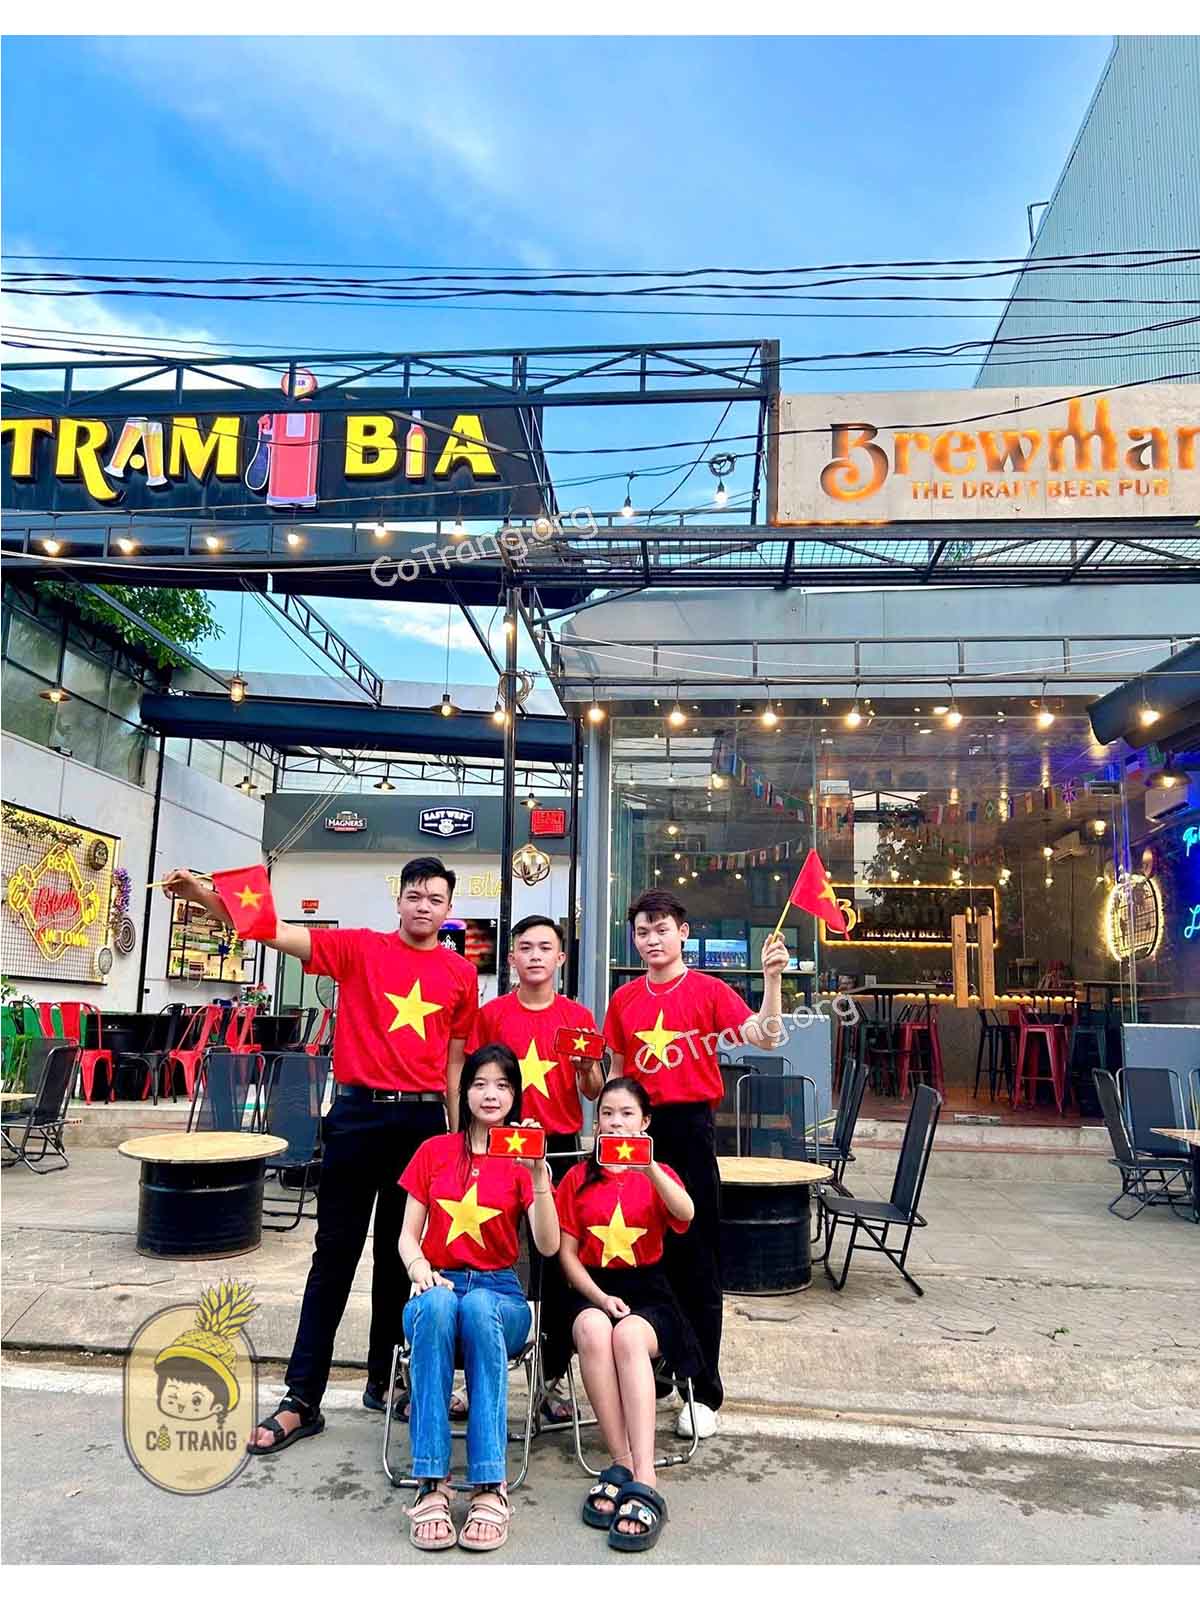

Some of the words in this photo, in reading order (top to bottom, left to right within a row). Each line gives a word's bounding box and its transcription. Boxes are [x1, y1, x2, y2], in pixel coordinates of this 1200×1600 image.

[911, 480, 954, 499] THE
[962, 480, 1039, 498] DRAFT
[1047, 479, 1111, 497] BEER
[328, 818, 364, 827] MAGNERS
